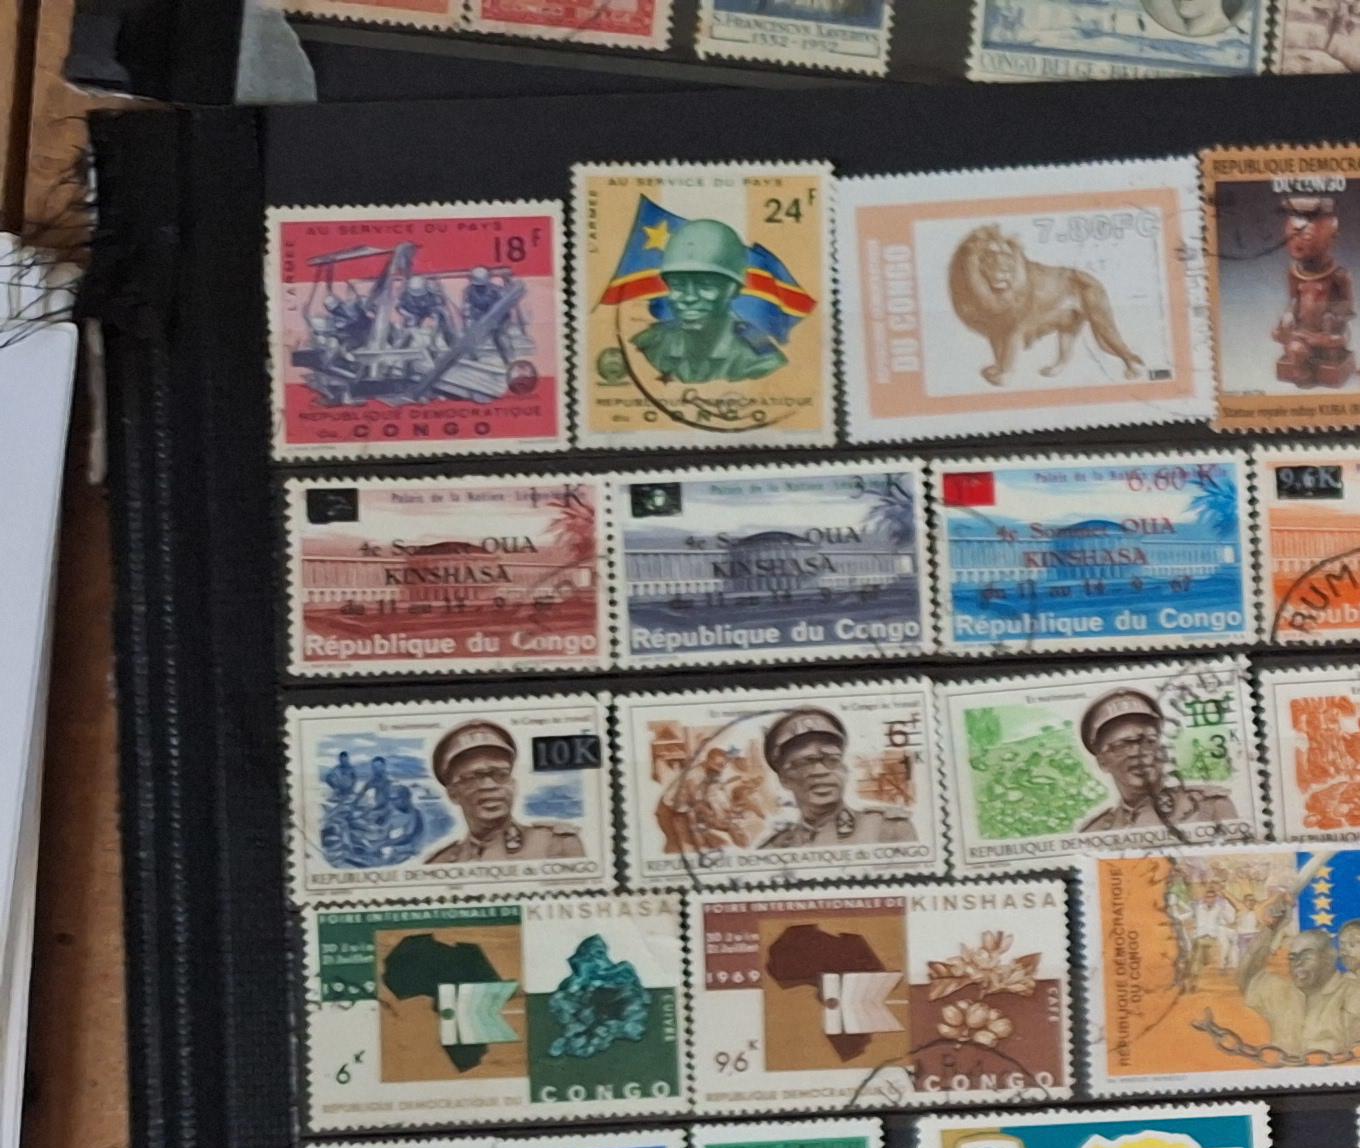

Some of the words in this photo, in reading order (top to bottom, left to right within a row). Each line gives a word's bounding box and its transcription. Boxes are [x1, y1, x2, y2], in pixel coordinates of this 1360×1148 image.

[353, 421, 490, 437] CONGO
[385, 564, 511, 586] KINSHASA
[633, 626, 784, 650] République
[793, 622, 825, 643] du
[836, 618, 920, 644] Congo
[957, 609, 1103, 638] République
[1118, 612, 1147, 631] du
[1157, 608, 1242, 634] Congo
[306, 635, 456, 659] République
[467, 632, 499, 654] du
[513, 630, 597, 653] Congo
[536, 740, 598, 767] 10K
[311, 868, 403, 885] REPUBLIQUE
[405, 865, 519, 882] DEMOCRATIQUE
[541, 861, 598, 877] CONGO
[527, 900, 675, 922] KINSHASA
[911, 893, 1056, 914] KINSHASA
[541, 1081, 671, 1105] CONGO
